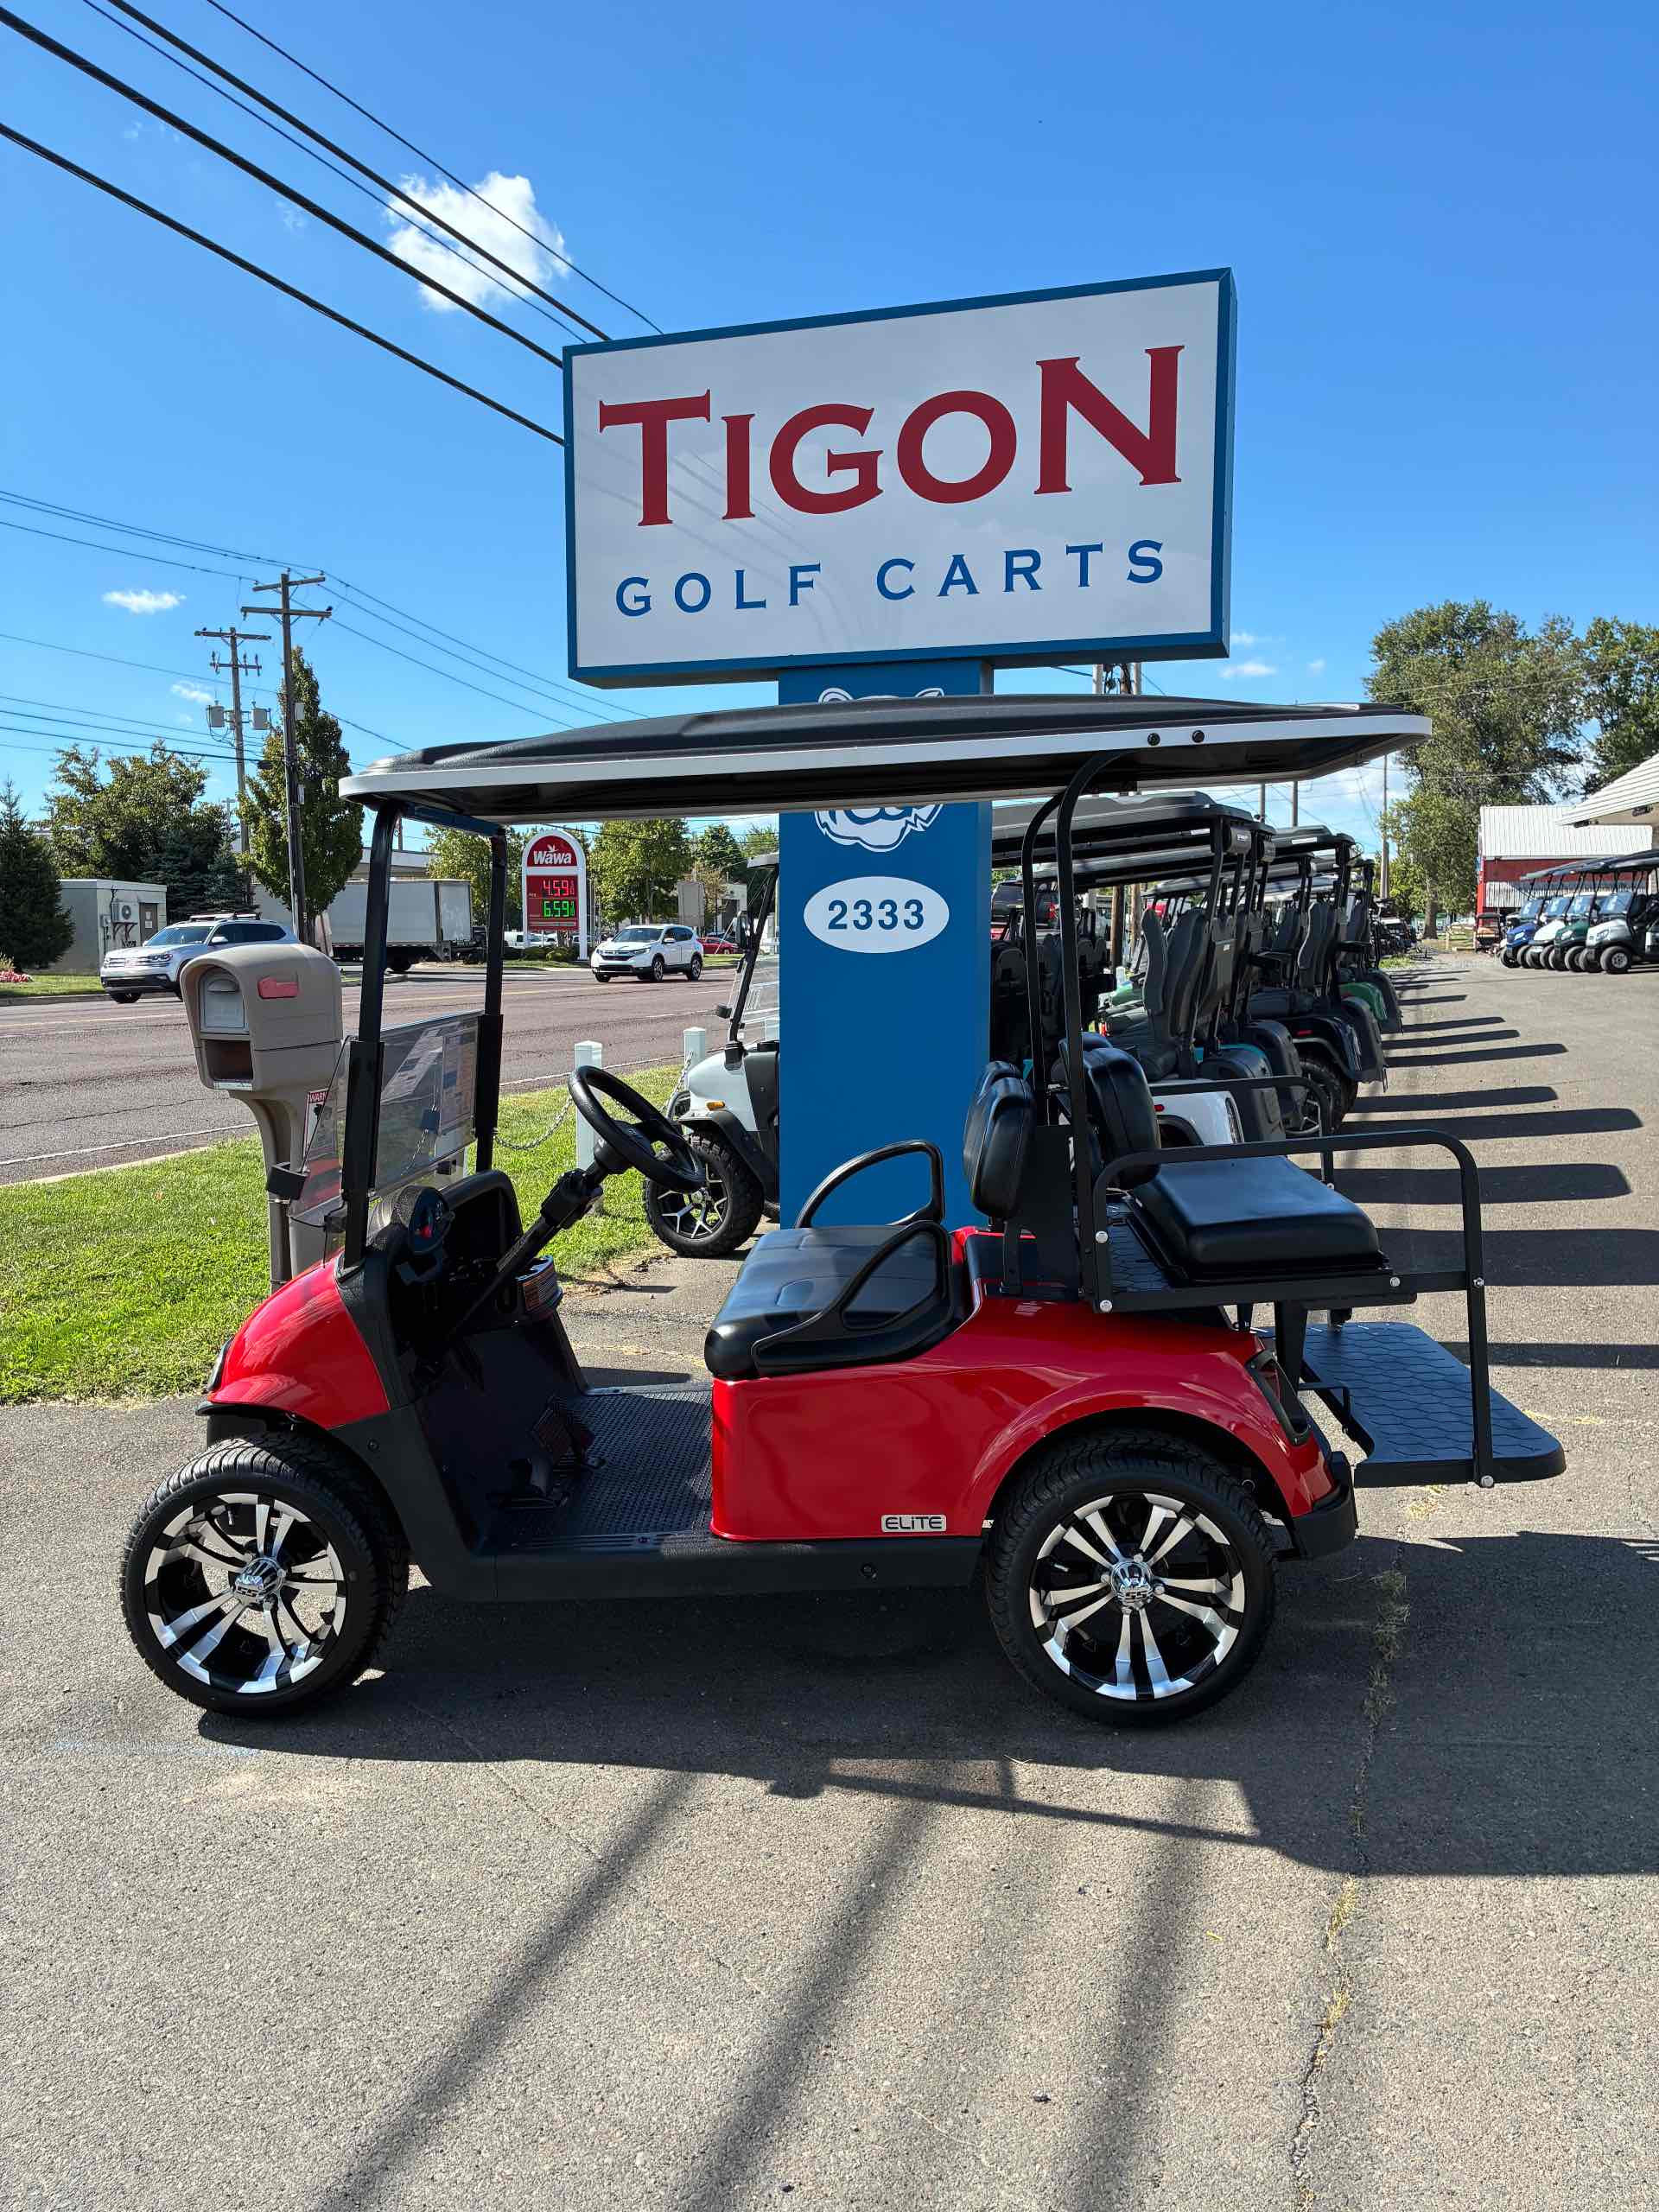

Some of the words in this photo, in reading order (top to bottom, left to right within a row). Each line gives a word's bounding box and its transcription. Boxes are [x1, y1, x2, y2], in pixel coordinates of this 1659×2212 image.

[599, 345, 1185, 526] TIGON
[616, 563, 821, 617] GOLF
[876, 539, 1163, 600] CARTS
[533, 850, 572, 864] Wawa
[828, 899, 924, 930] 2333
